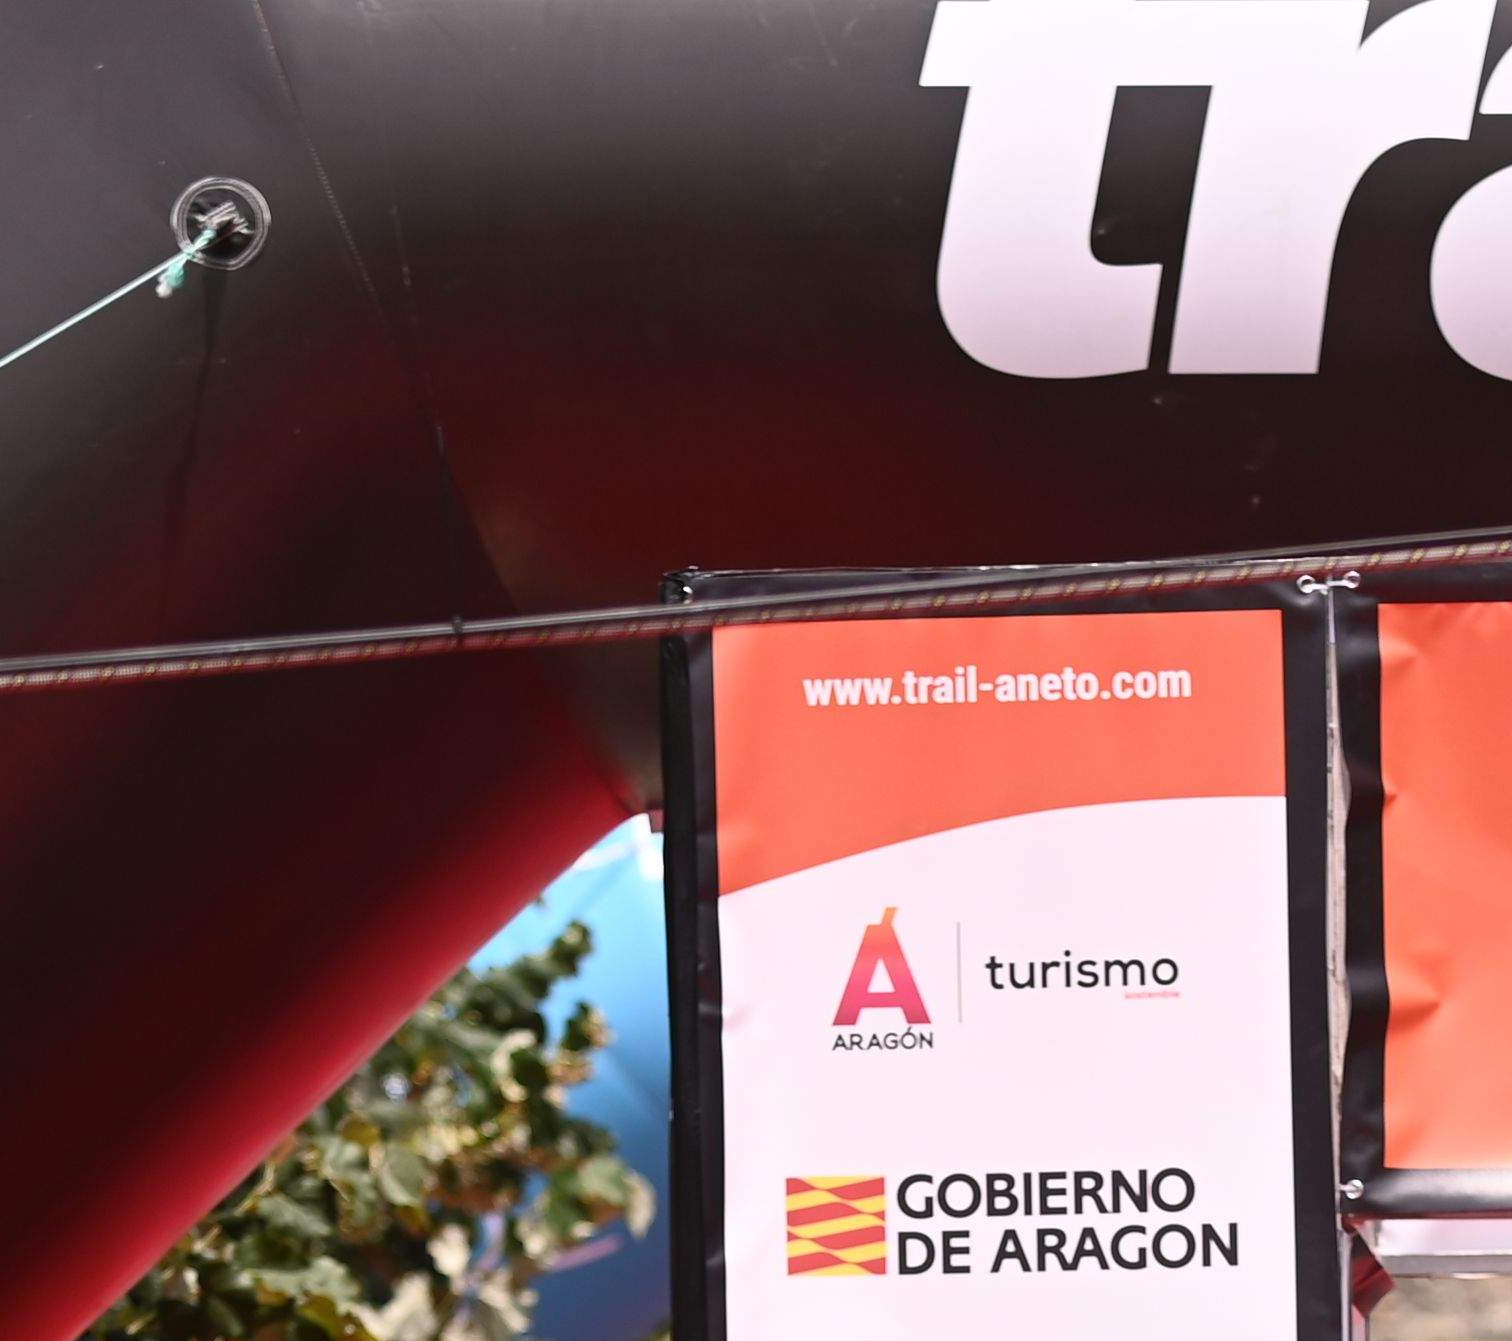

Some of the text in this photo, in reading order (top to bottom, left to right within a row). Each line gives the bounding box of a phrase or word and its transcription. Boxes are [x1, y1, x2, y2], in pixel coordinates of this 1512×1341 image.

[803, 664, 1192, 708] www.trail-aneto.com
[985, 950, 1179, 989] turismo
[832, 1027, 934, 1051] ARAGÓN
[897, 1166, 1196, 1220] GOBIERNO
[897, 1222, 1239, 1276] DE ARAGON
